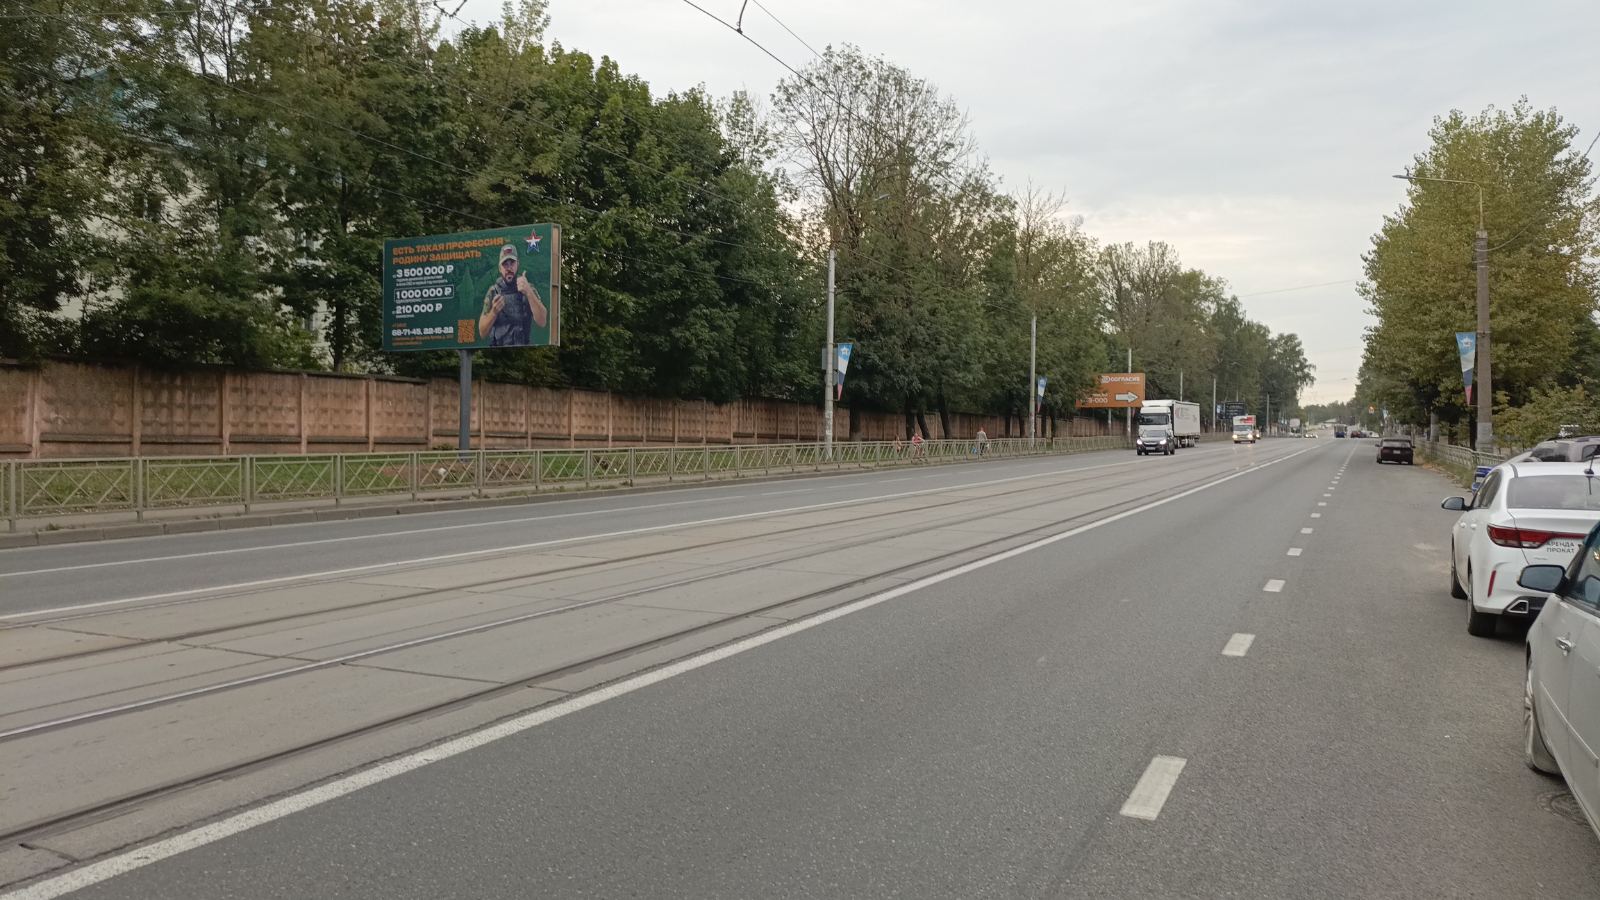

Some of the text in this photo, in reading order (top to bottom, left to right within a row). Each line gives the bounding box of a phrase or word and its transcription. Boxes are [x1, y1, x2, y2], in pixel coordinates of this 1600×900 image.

[393, 247, 415, 256] ЕСТЬ
[416, 244, 445, 253] ТАКАЯ
[446, 237, 504, 249] ПРОФЕССИЯ
[393, 251, 481, 265] РОДИНУ ЗАЩИЩАТЬ
